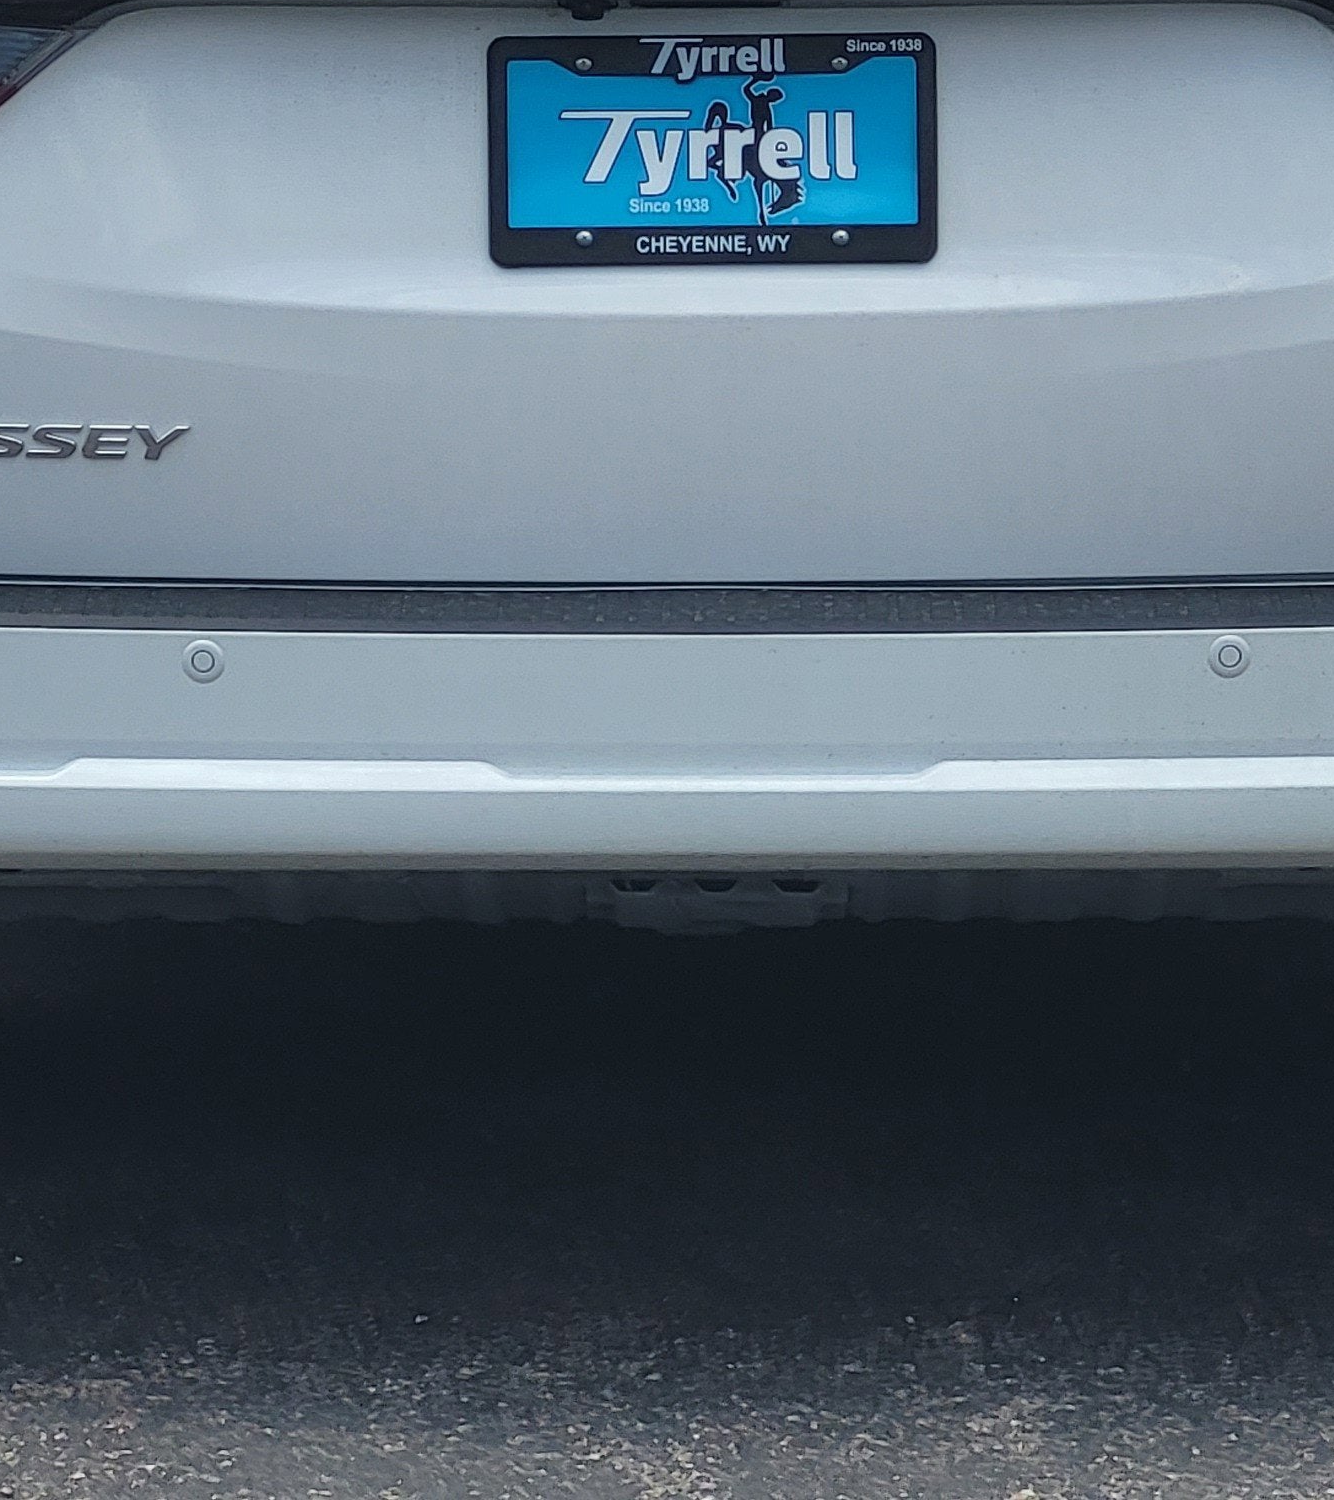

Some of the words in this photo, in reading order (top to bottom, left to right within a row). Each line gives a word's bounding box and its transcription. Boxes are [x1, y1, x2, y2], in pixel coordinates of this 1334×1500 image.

[846, 39, 886, 52] Since
[890, 39, 922, 52] 1938
[639, 37, 786, 80] Tyrrell
[559, 110, 858, 195] Tyrrell
[629, 198, 671, 213] Since
[675, 198, 709, 213] 1938
[636, 235, 753, 255] CHEYENNE,
[757, 234, 791, 252] WY
